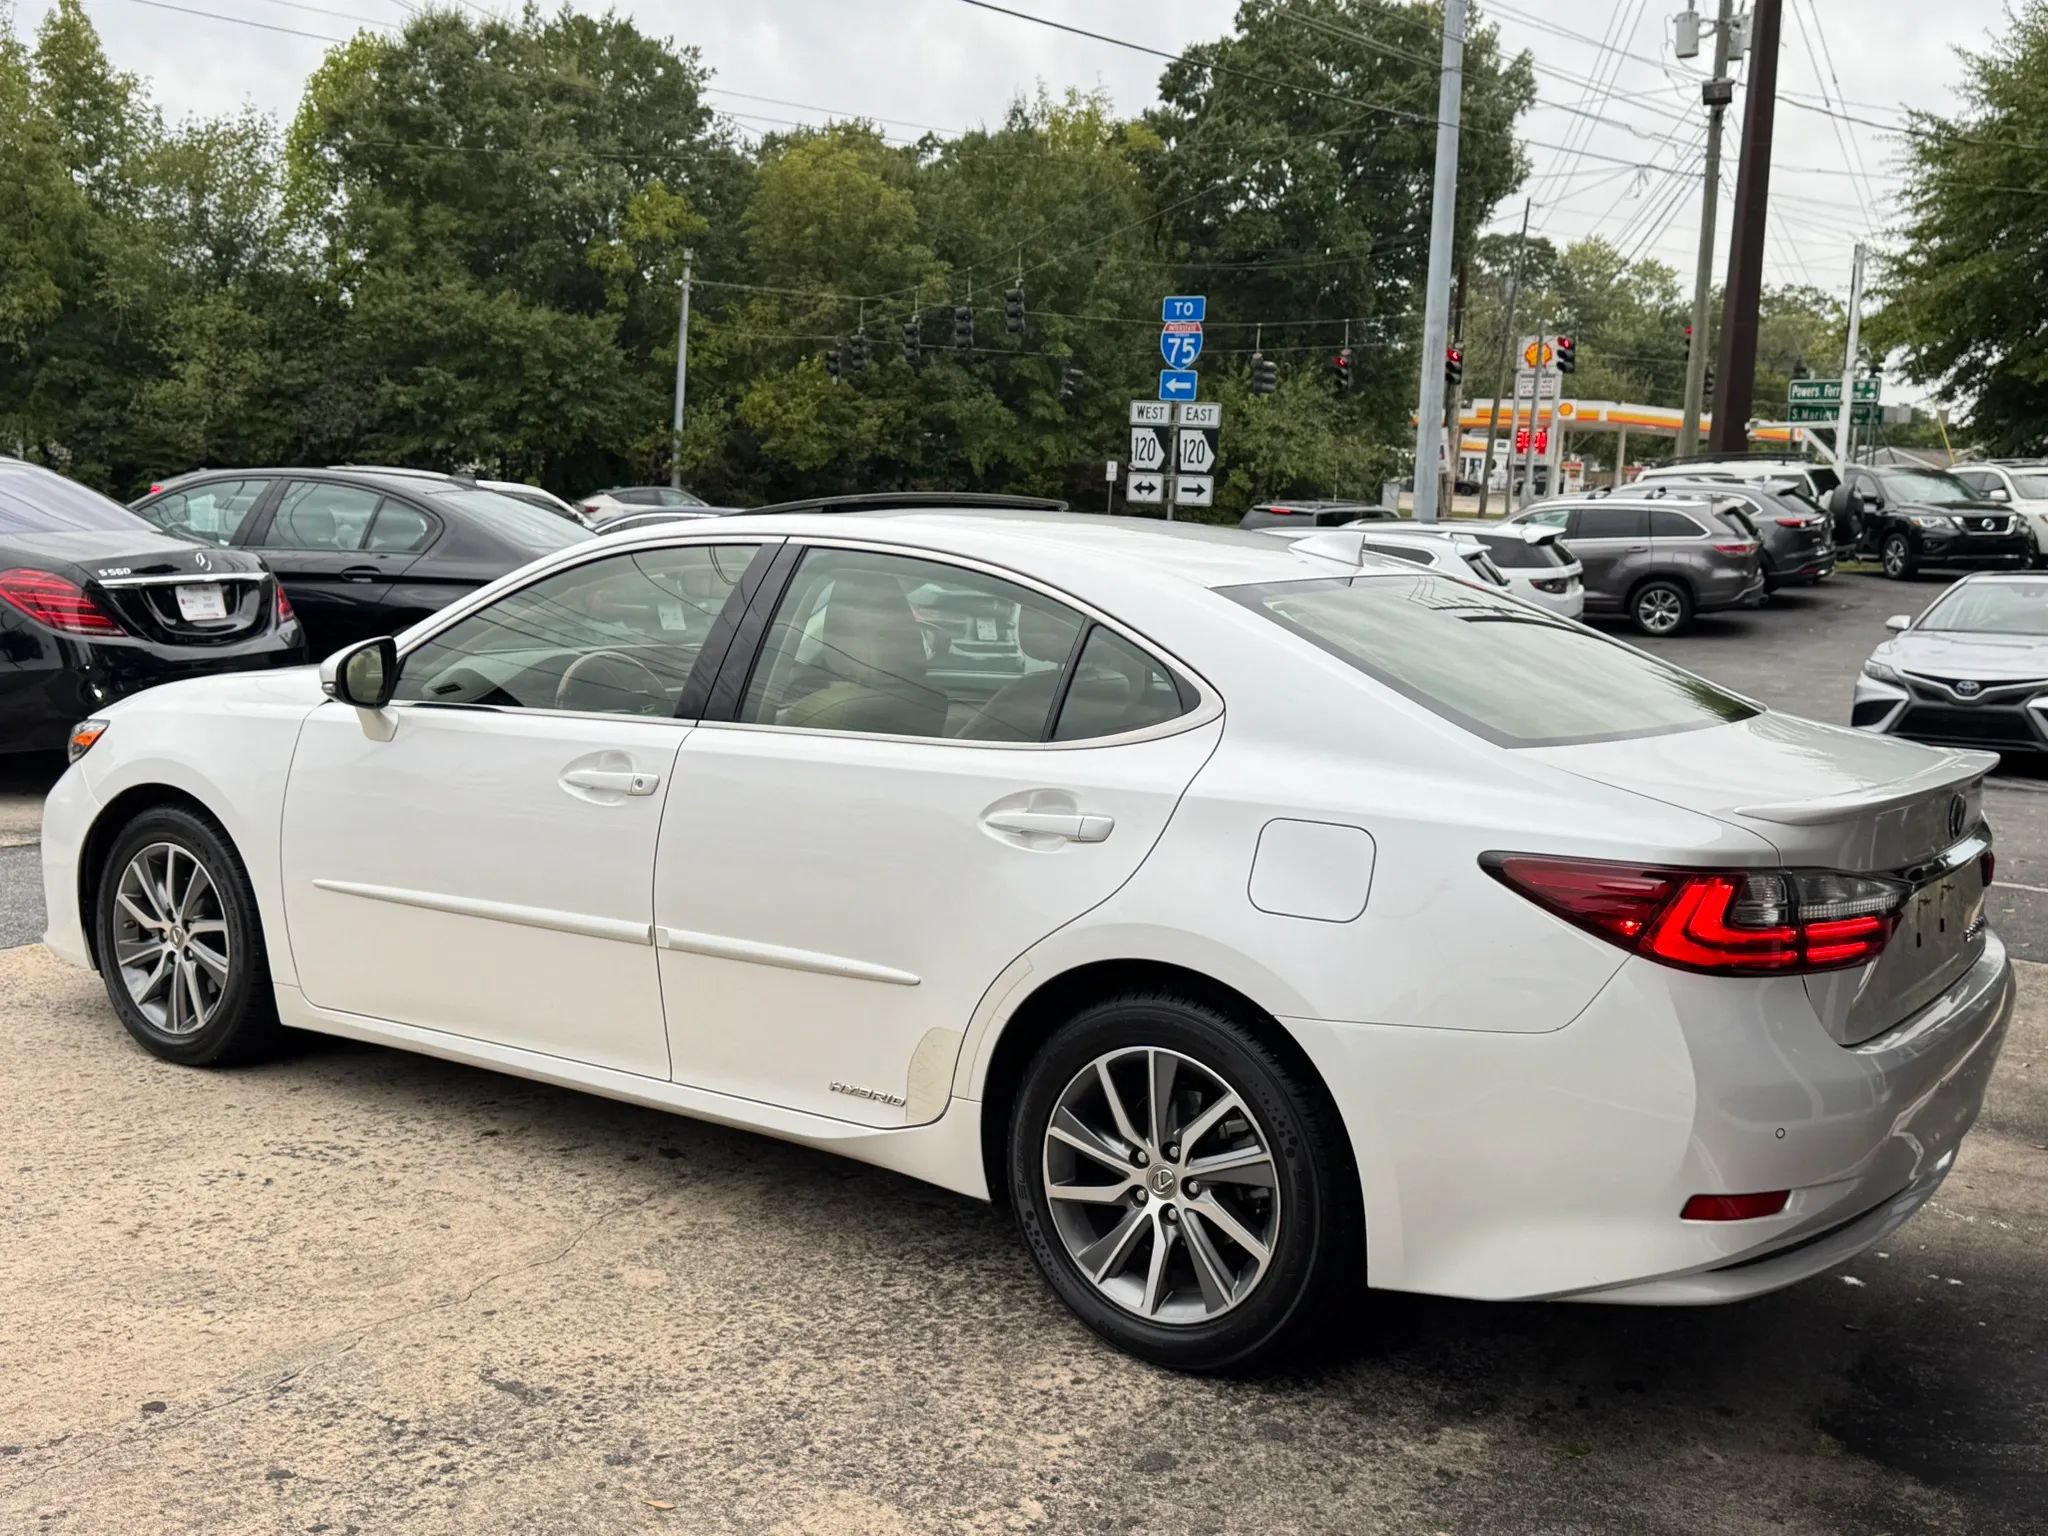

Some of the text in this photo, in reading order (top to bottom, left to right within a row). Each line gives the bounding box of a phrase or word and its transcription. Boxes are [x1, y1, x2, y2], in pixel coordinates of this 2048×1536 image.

[1174, 301, 1194, 316] TO
[1167, 338, 1196, 365] 75
[1791, 384, 1820, 398] Powers
[1824, 383, 1841, 398] Ferr
[1136, 406, 1165, 420] WEST
[1185, 407, 1214, 422] EAST
[1134, 437, 1156, 462] 120
[1183, 439, 1205, 464] 120
